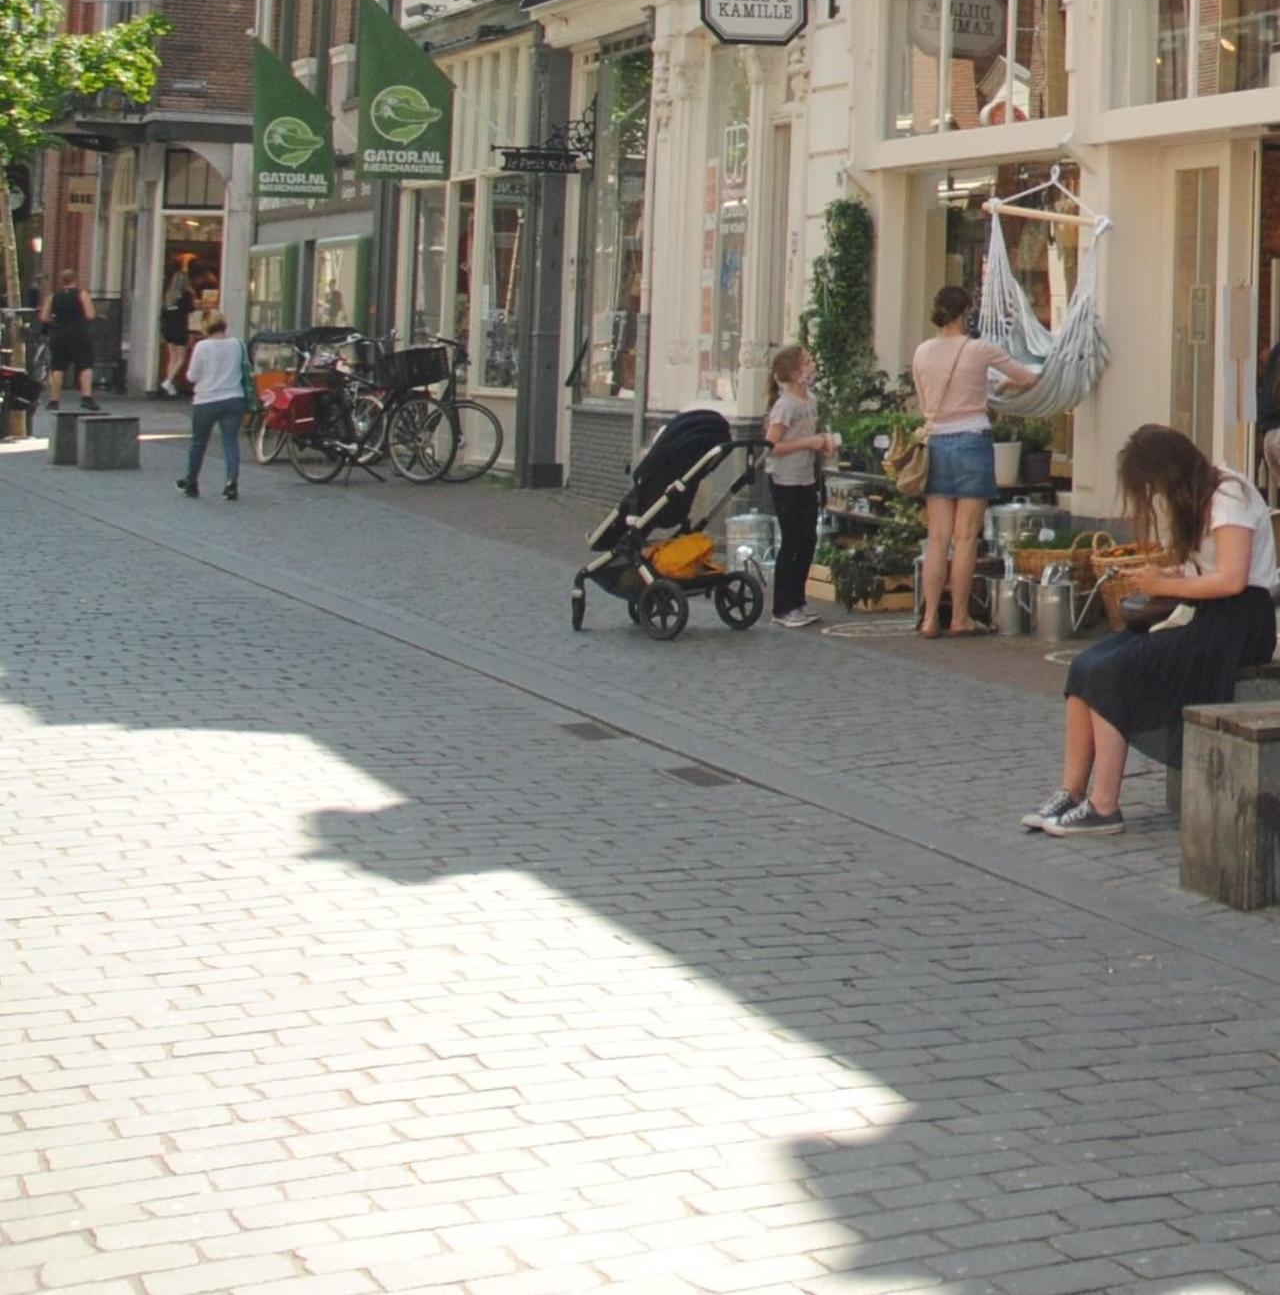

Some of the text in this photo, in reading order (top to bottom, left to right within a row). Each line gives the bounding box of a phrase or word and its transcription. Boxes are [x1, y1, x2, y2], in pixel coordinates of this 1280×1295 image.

[718, 2, 793, 20] KAMILLE
[363, 149, 445, 164] GATOR.NL
[363, 163, 444, 174] MERCHANDISE
[259, 171, 328, 186] GATOR.NL
[259, 184, 328, 194] MERCHANDISE
